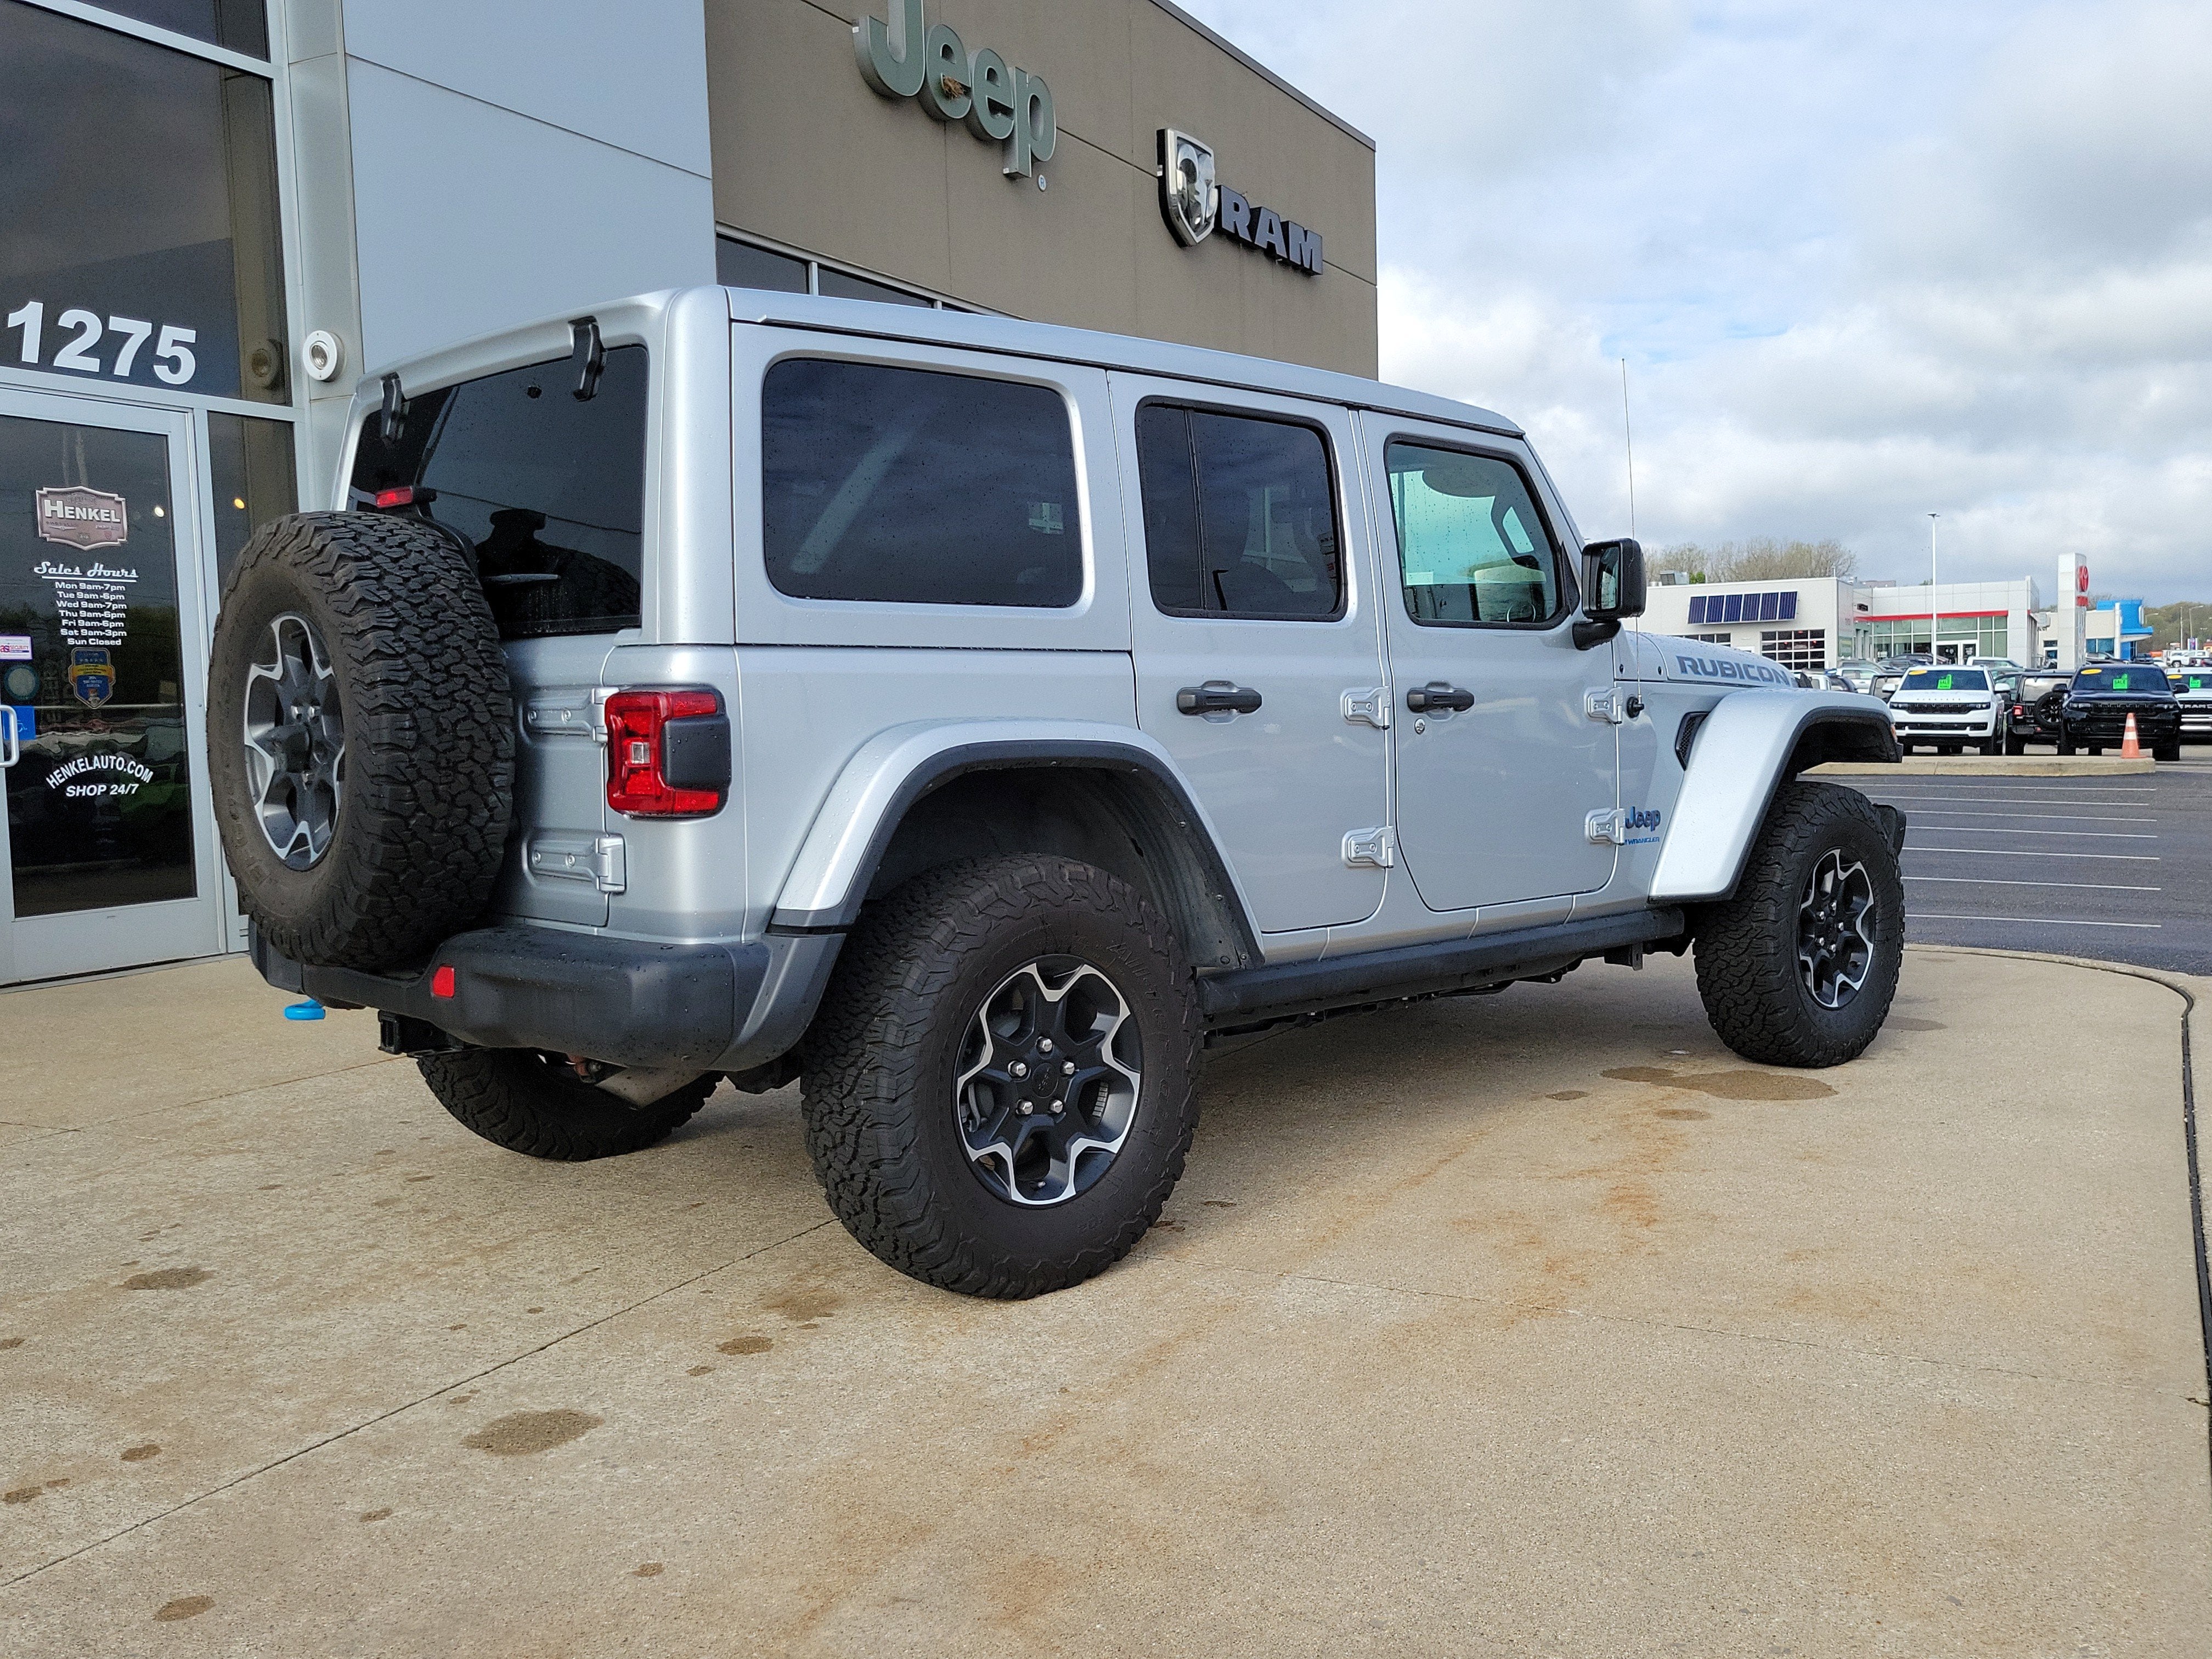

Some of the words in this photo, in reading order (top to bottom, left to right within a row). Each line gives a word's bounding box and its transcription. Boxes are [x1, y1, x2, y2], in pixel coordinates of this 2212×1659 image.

[853, 0, 1056, 178] Jeep
[1215, 185, 1323, 275] RAM
[8, 301, 196, 384] 1275
[44, 499, 121, 523] HENKEL
[33, 561, 83, 575] Sales
[87, 562, 139, 578] Hours
[79, 583, 126, 591] 9am-7pm
[80, 611, 126, 619] 9am-6pm
[81, 601, 127, 610] 9am-7pm
[77, 620, 125, 628] 9am-6pm
[81, 629, 127, 637] 9am-3pm
[1675, 656, 1790, 686] RUBICON
[46, 755, 154, 789] HENKELAUTO.COM
[65, 785, 107, 797] SHOP
[110, 783, 139, 795] 24/7
[1625, 806, 1661, 832] Jeep
